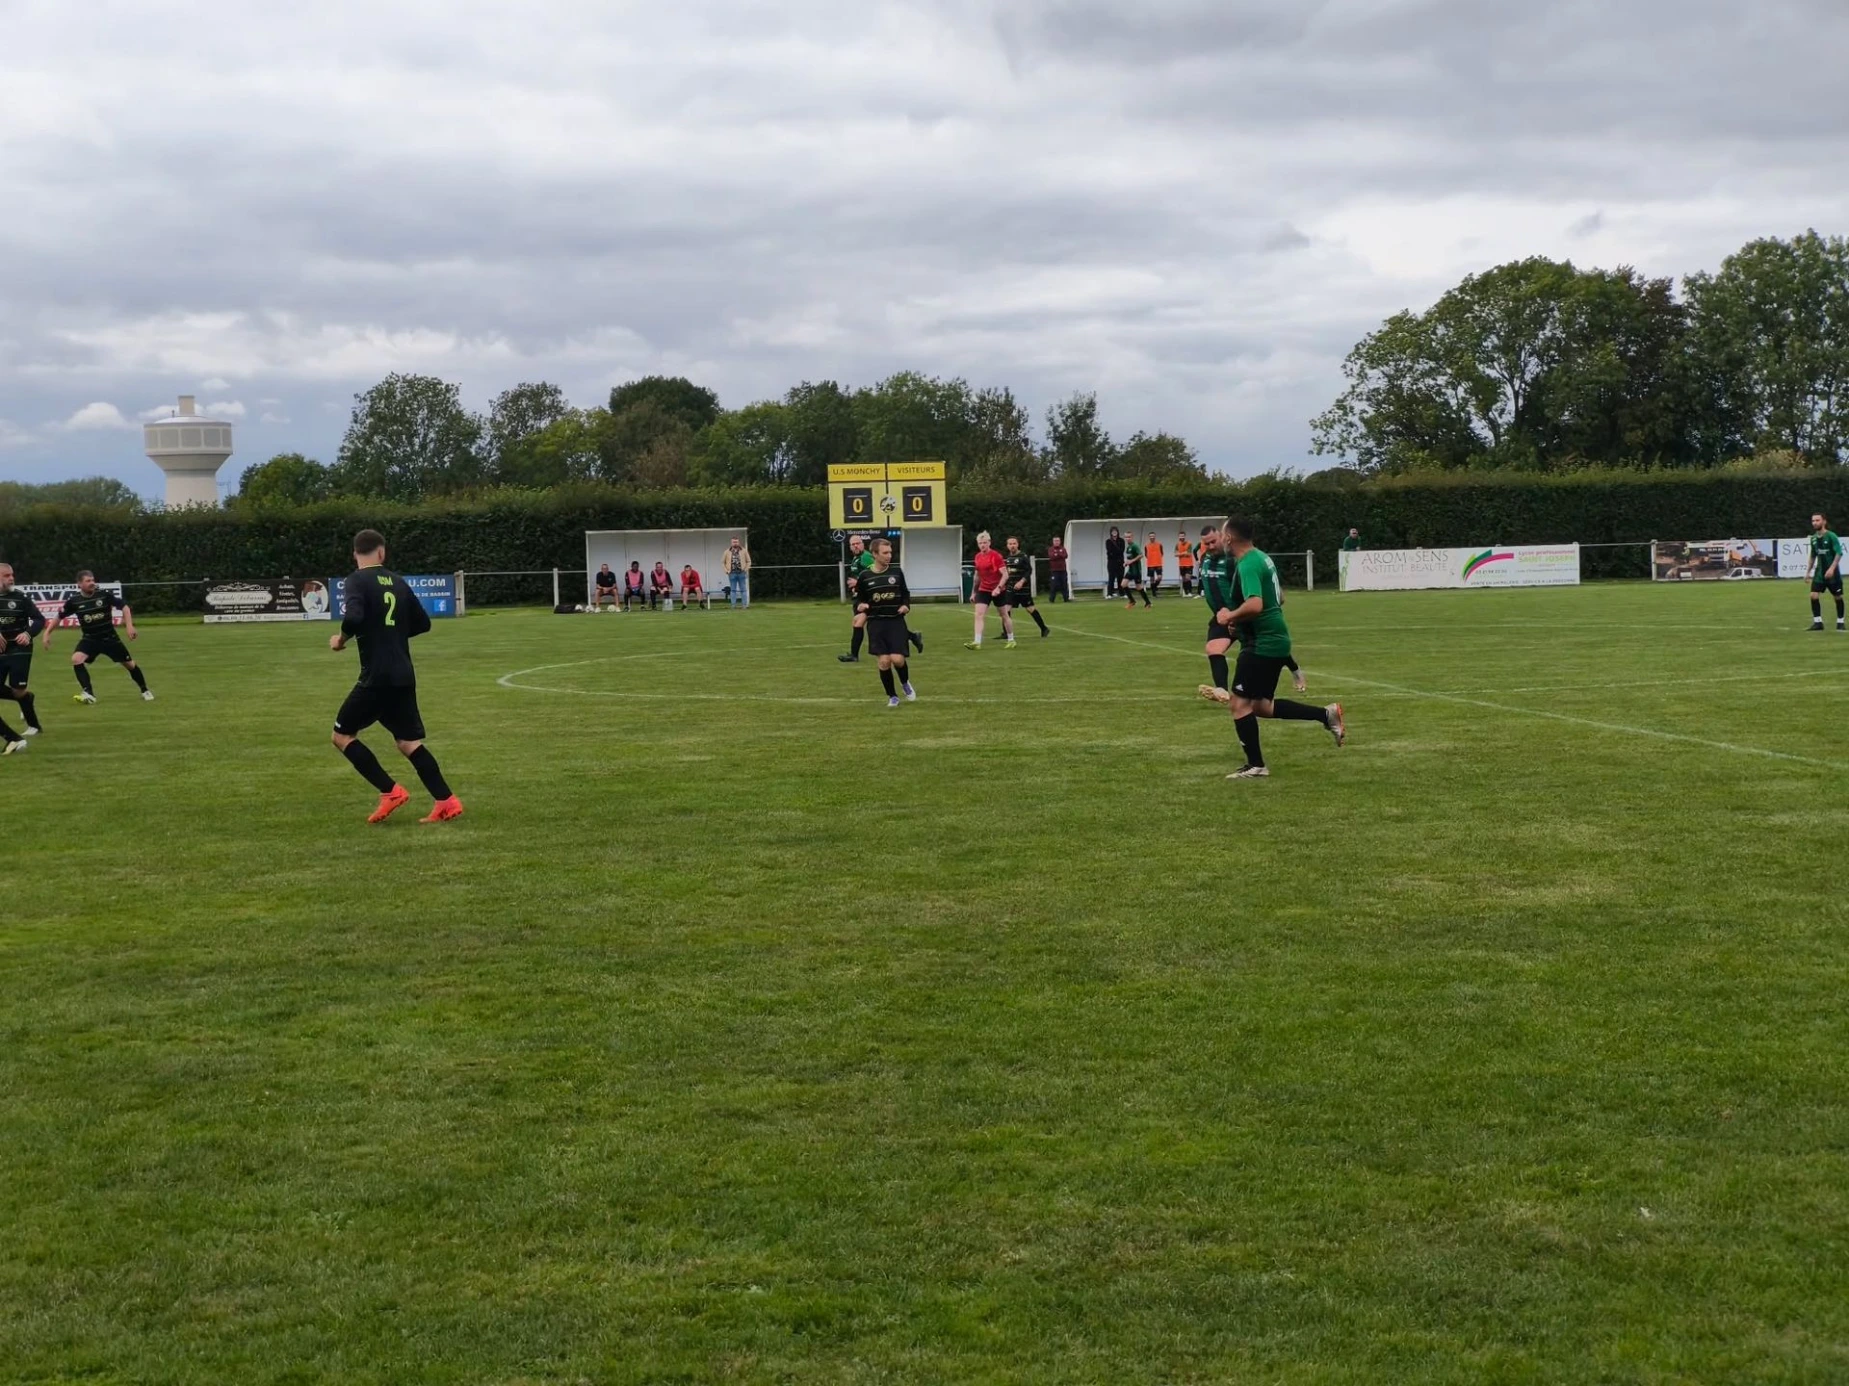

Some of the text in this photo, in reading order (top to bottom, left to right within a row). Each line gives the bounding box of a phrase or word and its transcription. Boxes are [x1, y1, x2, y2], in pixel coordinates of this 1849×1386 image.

[896, 466, 936, 474] VISITEURS
[852, 497, 864, 514] 0
[912, 496, 923, 512] 0
[1361, 551, 1407, 565] AROM
[1415, 550, 1449, 562] SENS
[1363, 564, 1405, 574] INSTITUT
[383, 591, 396, 626] 2
